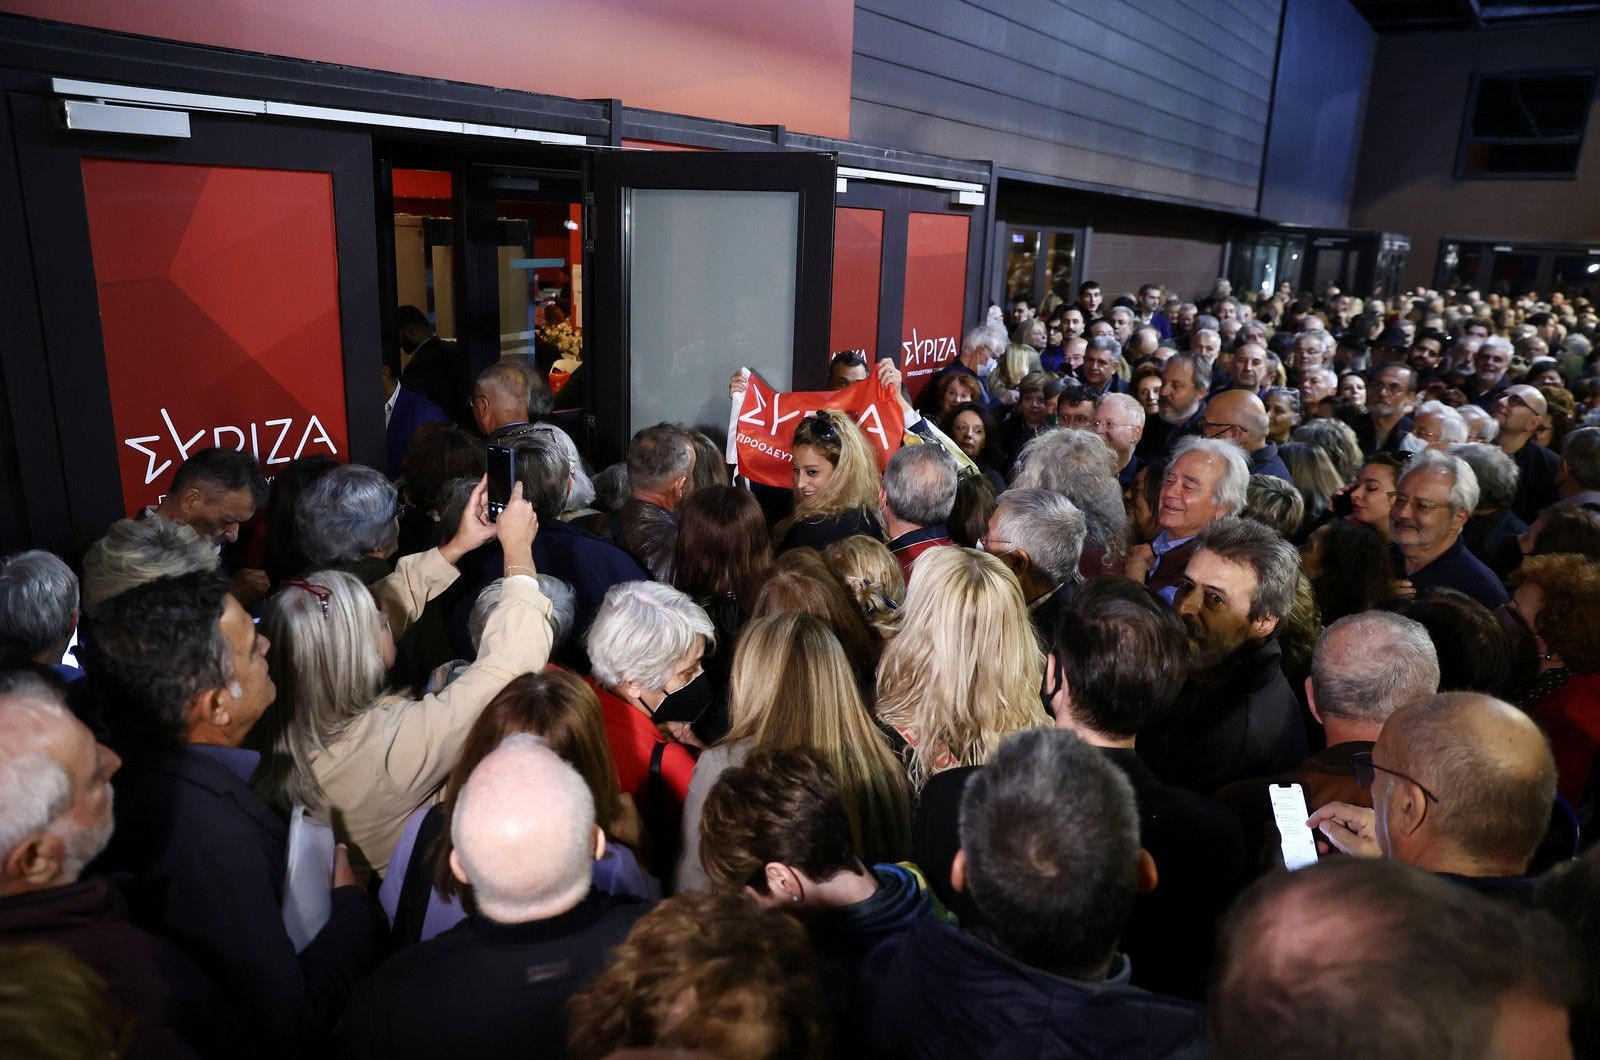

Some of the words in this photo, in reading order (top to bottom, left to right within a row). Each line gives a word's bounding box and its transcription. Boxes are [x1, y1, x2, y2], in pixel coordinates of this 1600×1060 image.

[902, 328, 958, 367] ΣΥΡΙΖΑ
[739, 383, 890, 451] ΣΥΑ
[124, 408, 338, 484] ΣΥΡΙΖΑ
[736, 432, 793, 463] ΠΡΟΟΔΕΥΤ
